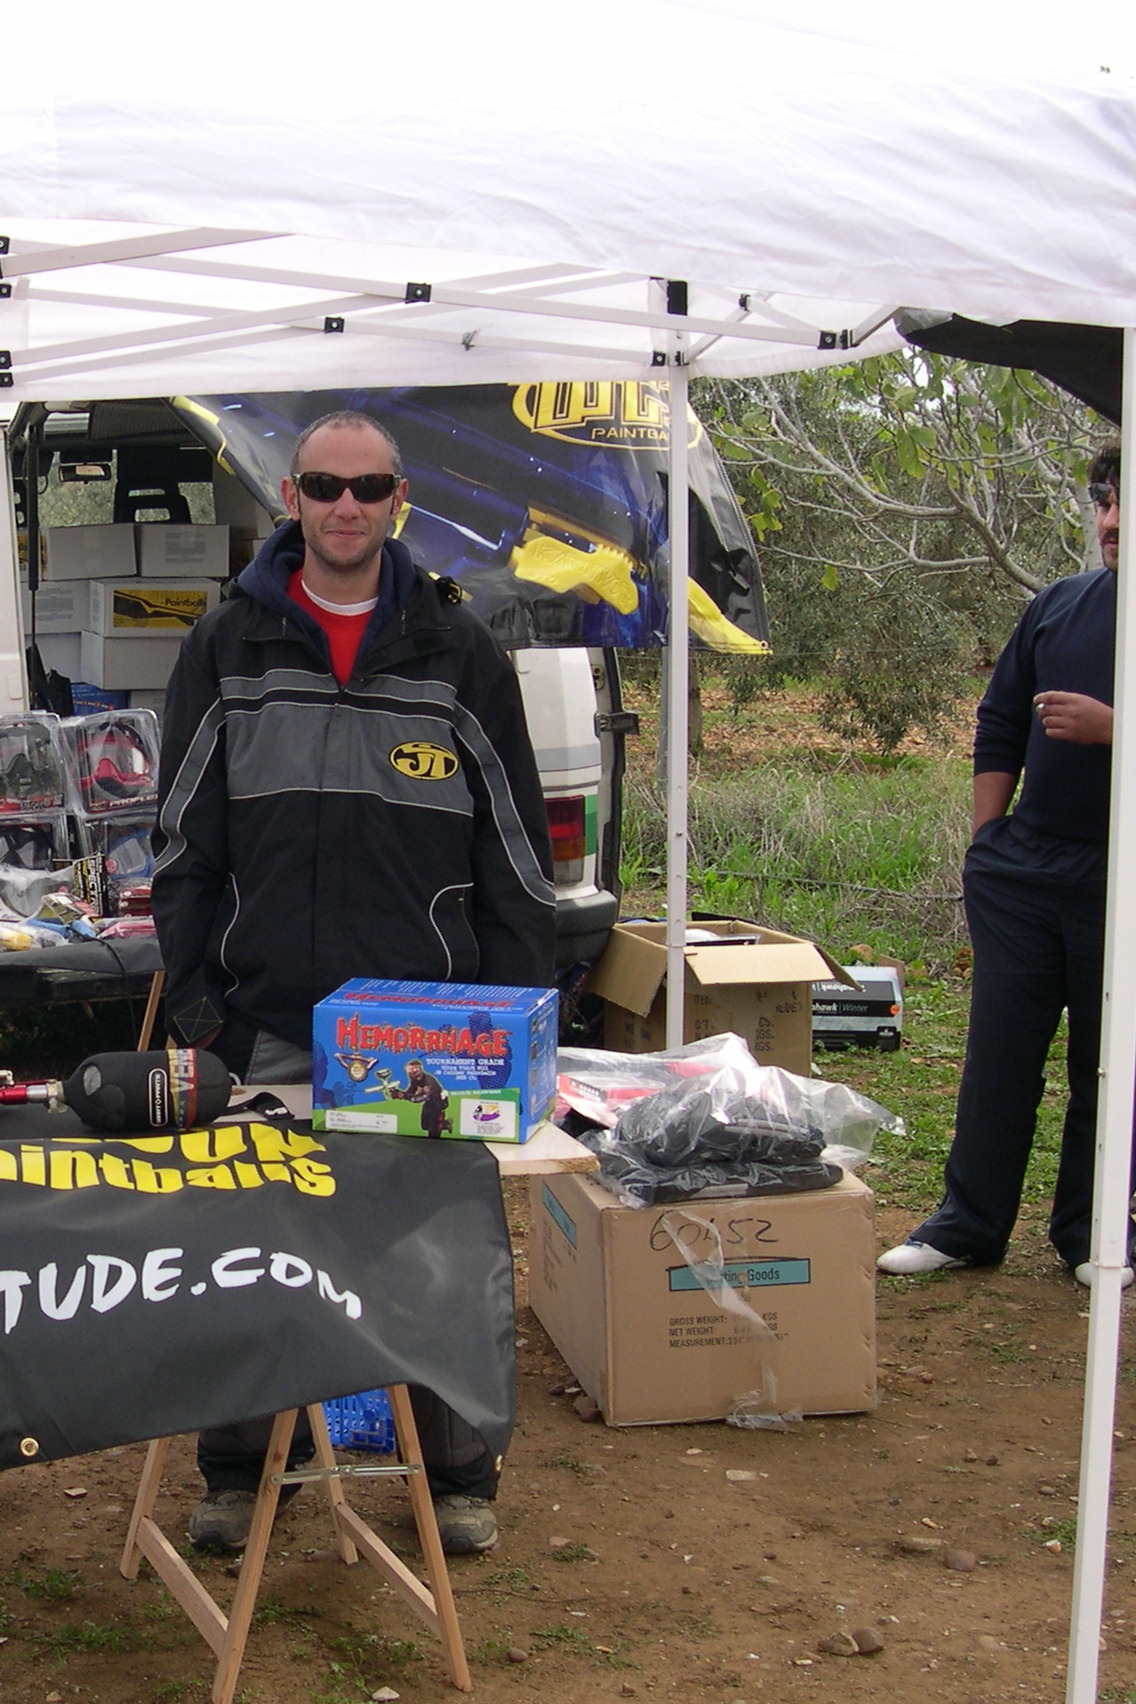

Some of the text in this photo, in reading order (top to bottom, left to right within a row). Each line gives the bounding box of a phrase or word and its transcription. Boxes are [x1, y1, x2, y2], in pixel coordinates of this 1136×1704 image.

[591, 427, 670, 441] PAINTBA
[336, 1013, 509, 1058] HEMORRHAGE
[747, 1267, 781, 1281] Goods
[669, 1316, 695, 1327] GROSS
[696, 1314, 728, 1326] WEIGHT:
[669, 1328, 683, 1338] NET
